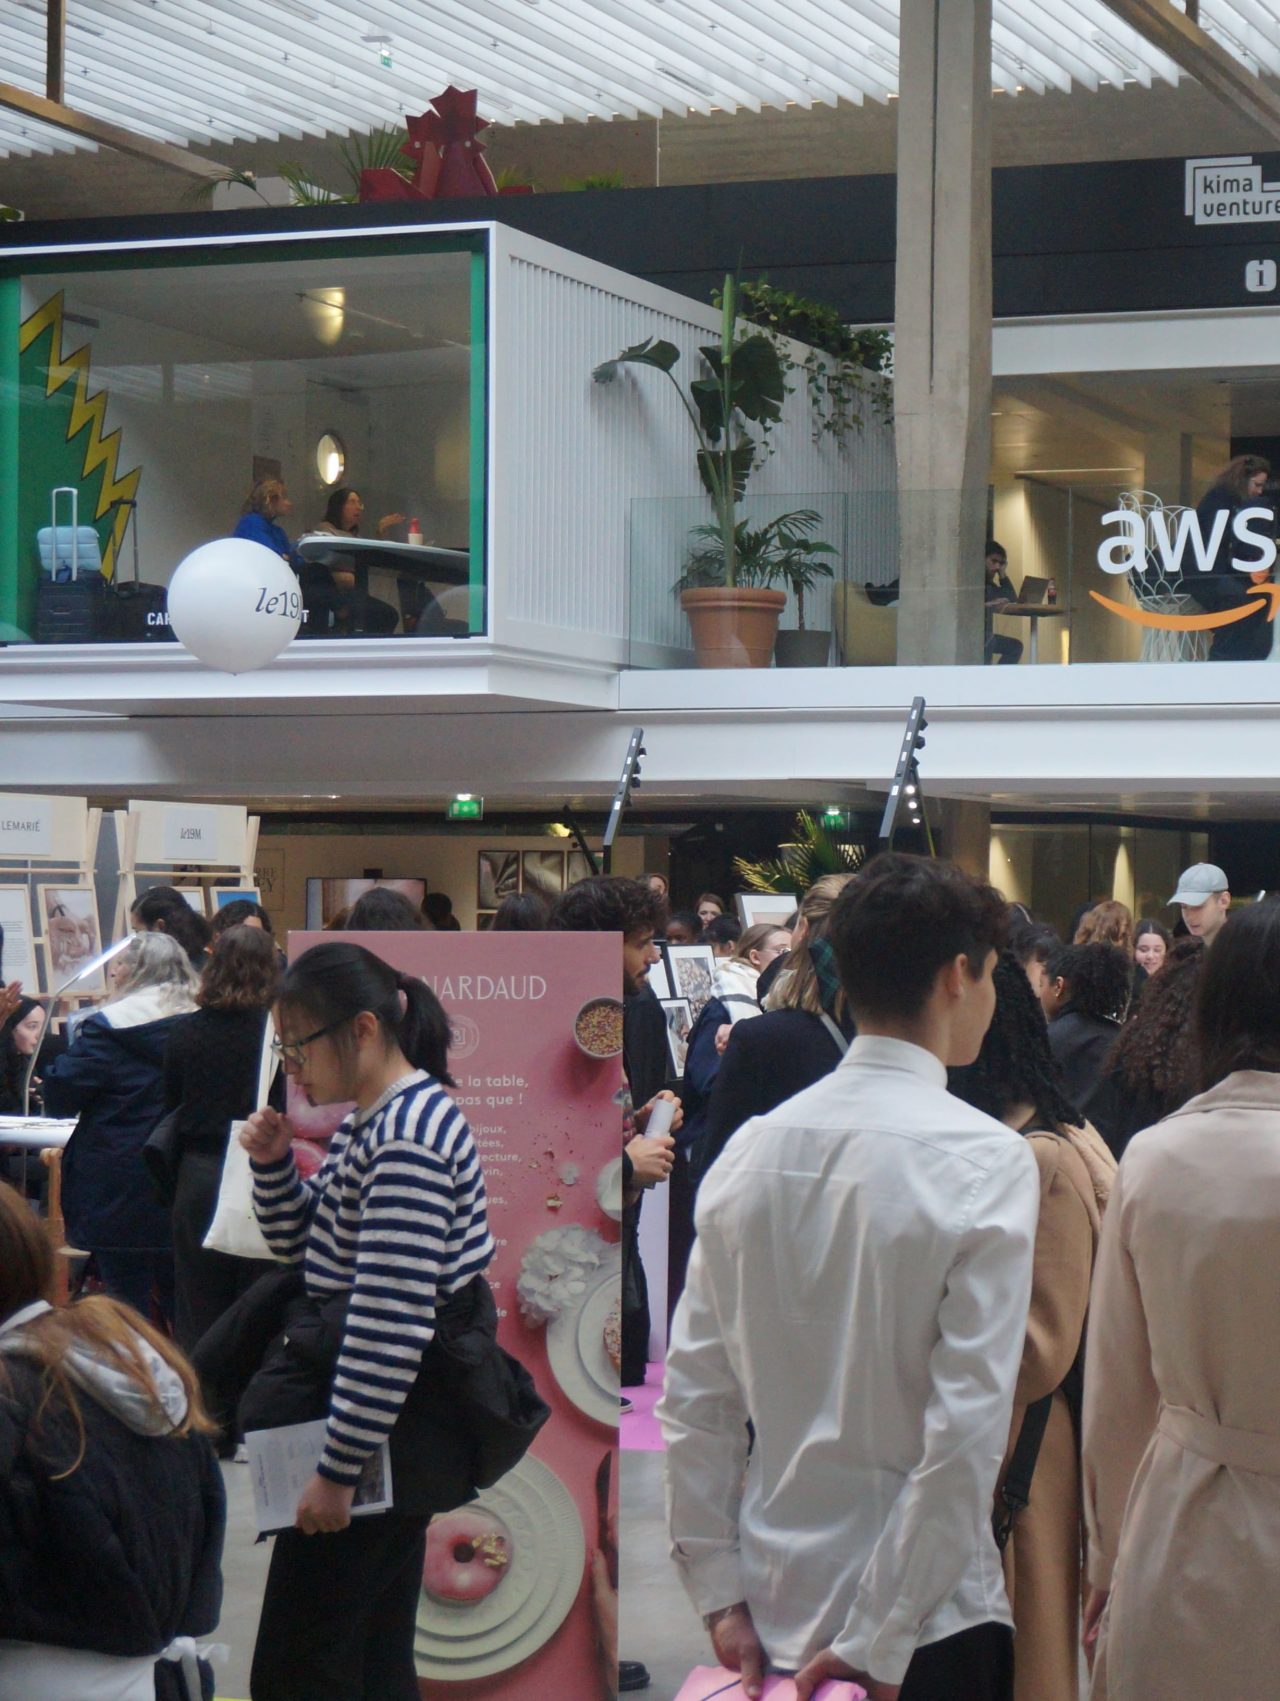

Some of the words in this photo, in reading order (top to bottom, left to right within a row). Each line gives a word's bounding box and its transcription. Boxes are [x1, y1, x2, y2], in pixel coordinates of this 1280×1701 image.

[1203, 174, 1254, 194] kima
[1097, 507, 1277, 575] aws
[255, 587, 301, 620] le19
[421, 975, 547, 1000] NARDAUD
[468, 1074, 481, 1087] la
[486, 1074, 529, 1089] table,
[486, 1096, 513, 1109] que
